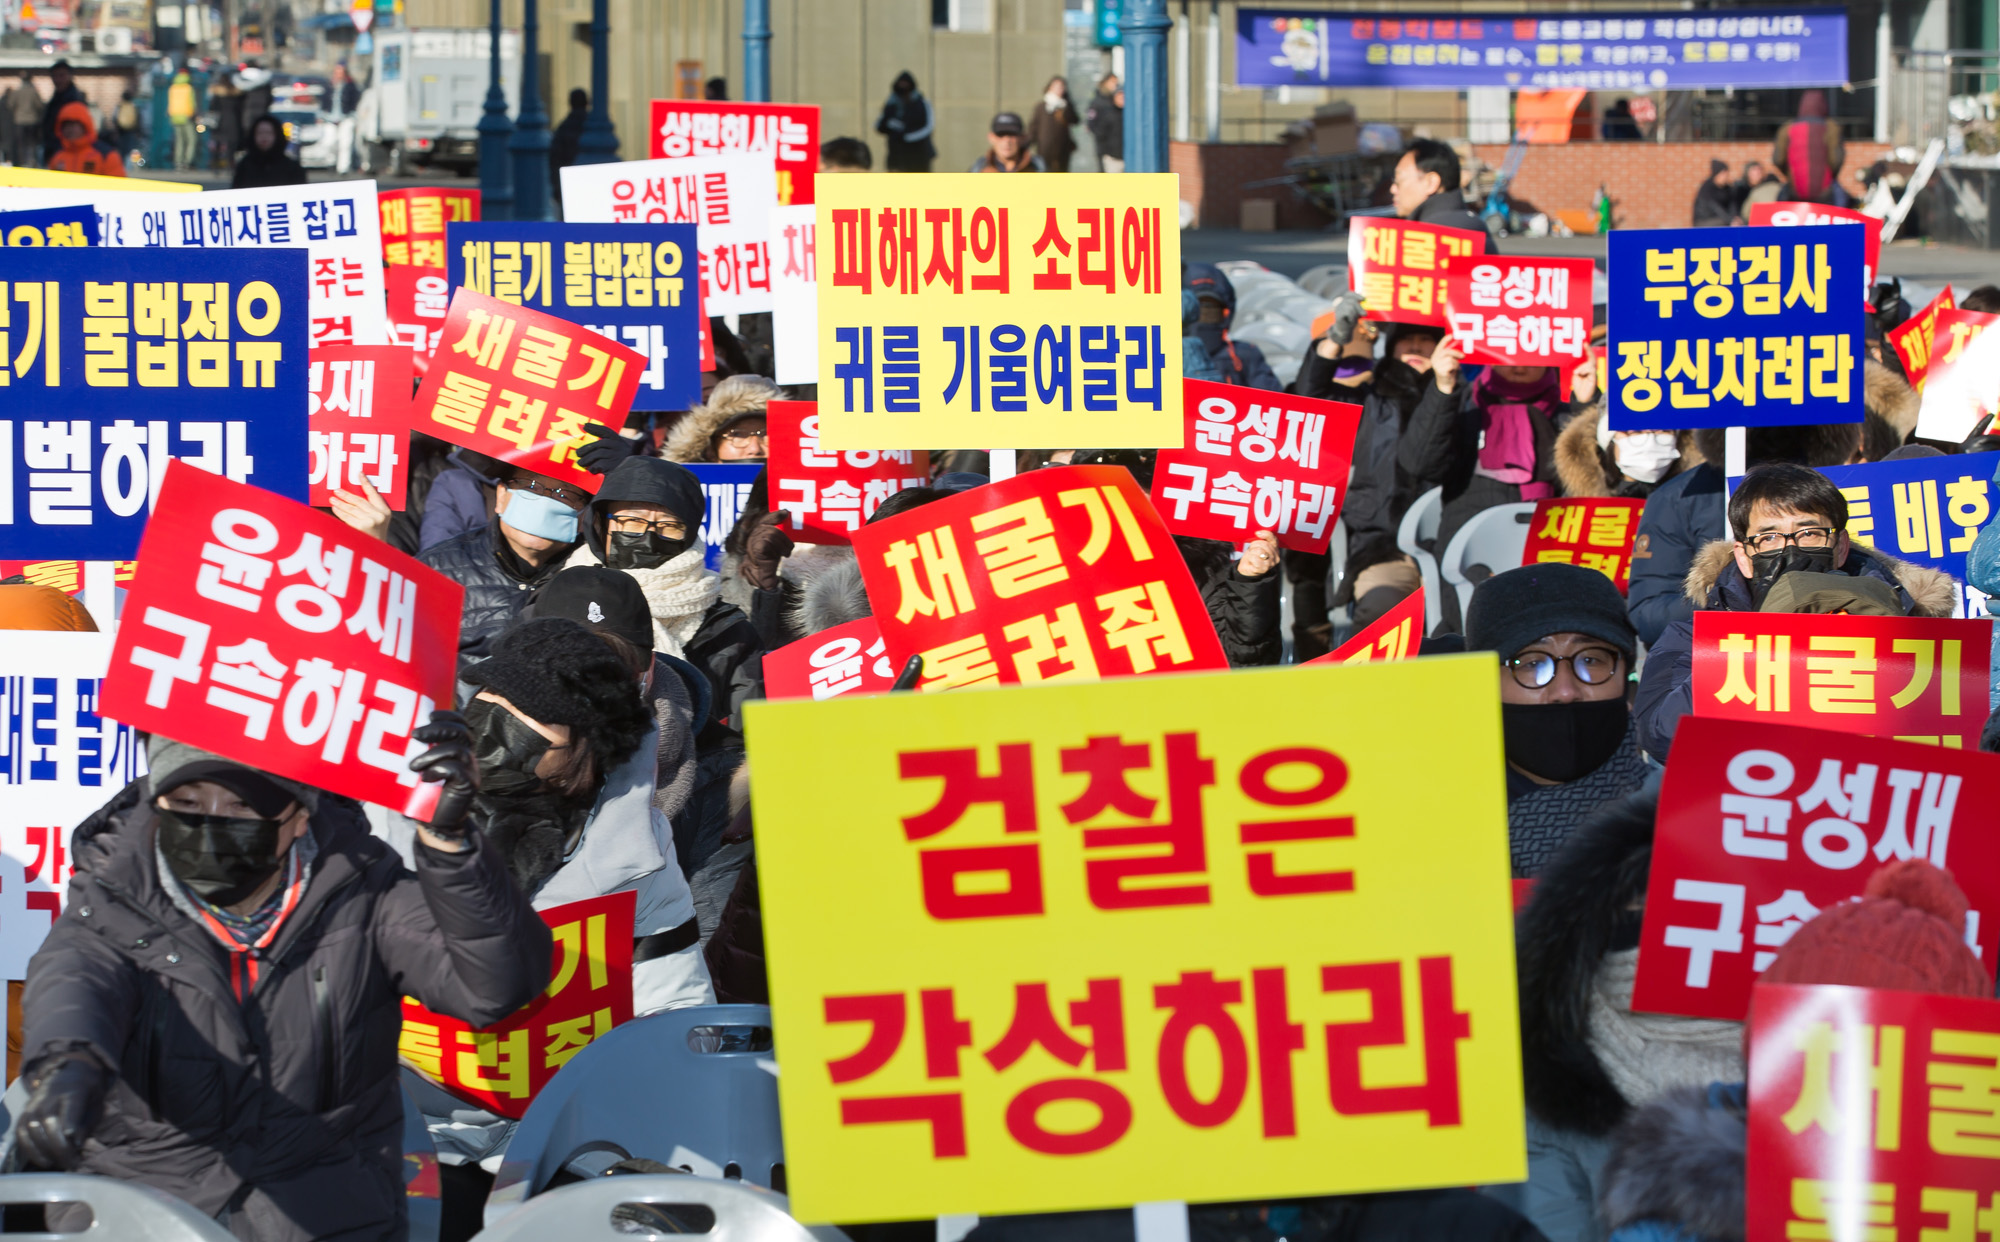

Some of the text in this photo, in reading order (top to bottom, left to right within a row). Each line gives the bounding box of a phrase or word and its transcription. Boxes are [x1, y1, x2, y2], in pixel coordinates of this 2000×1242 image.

[142, 211, 167, 248] 왜
[180, 203, 291, 248] 피해자를
[303, 198, 357, 241] 잡고
[380, 196, 472, 236] 채굴기
[612, 171, 731, 226] 윤성재를
[314, 257, 365, 299] 주는
[461, 240, 684, 307] 채굴기 불법점유
[699, 241, 771, 296] 하라
[832, 206, 1162, 295] 피해자의 소리에
[1469, 264, 1570, 310] 윤성재
[1644, 243, 1832, 319] 부장검사
[0, 280, 283, 388] 기 불법점유
[452, 308, 627, 410] 채굴기
[834, 323, 1166, 414] 귀를 기울여달라
[1453, 312, 1586, 358] 구속하라
[1616, 333, 1855, 412] 정신차려라
[430, 370, 605, 473] 돌려줘
[1194, 397, 1326, 469] 윤성재
[0, 419, 254, 526] 벌하라
[778, 477, 926, 532] 구속하
[1162, 463, 1336, 539] 구속하라
[884, 485, 1154, 625] 채굴기
[1537, 505, 1645, 548] 채굴
[195, 508, 417, 663] 윤성재
[129, 605, 436, 788] 구속하라
[1714, 633, 1963, 716] 채굴기
[897, 730, 1357, 922] 검찰은
[1721, 749, 1963, 870] 윤성재
[822, 954, 1472, 1160] 각성하라
